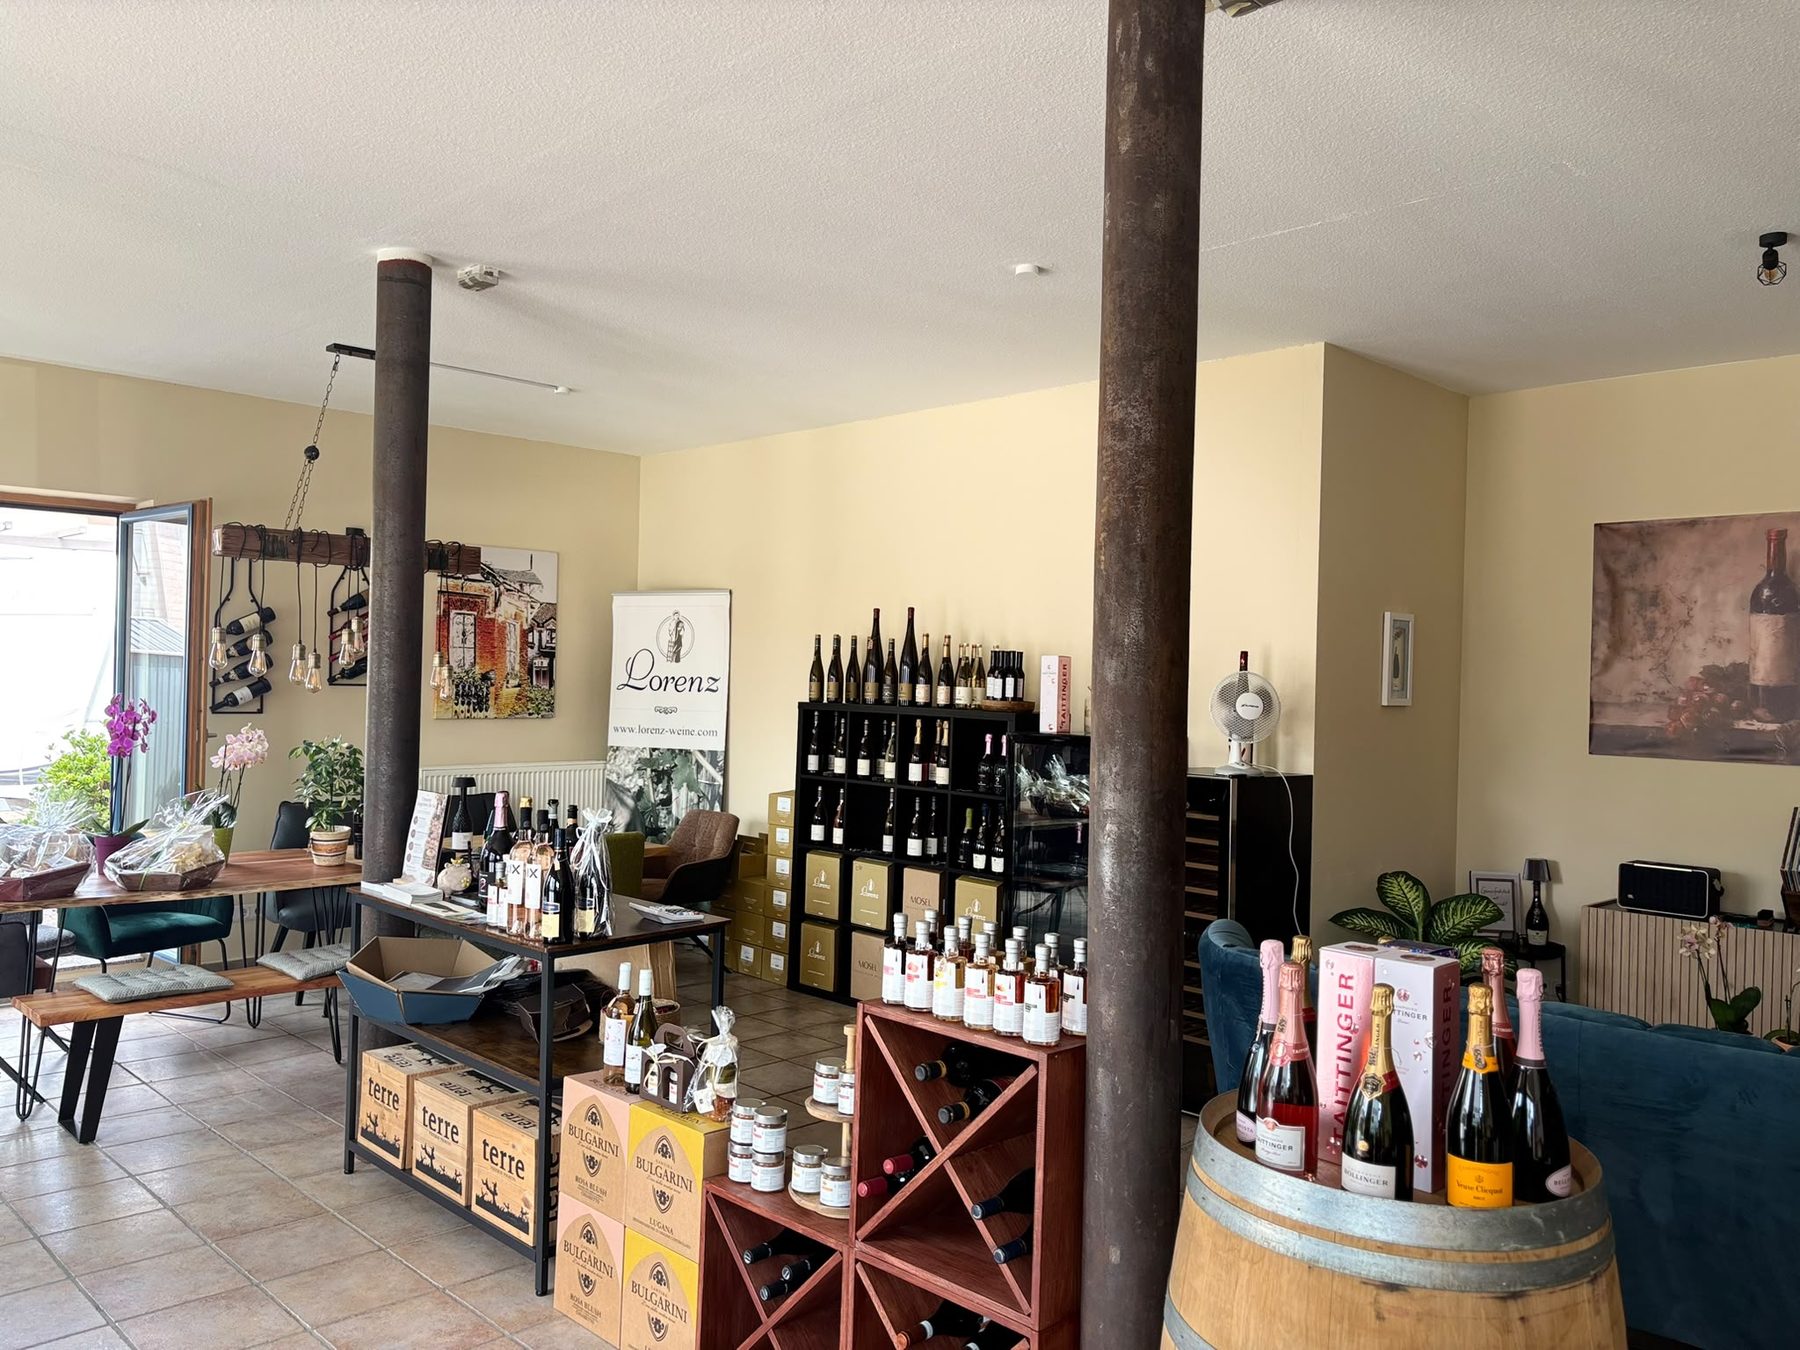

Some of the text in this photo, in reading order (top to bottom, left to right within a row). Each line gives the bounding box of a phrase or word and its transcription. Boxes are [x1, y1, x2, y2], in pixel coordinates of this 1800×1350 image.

[617, 648, 721, 693] Lorenz
[1060, 664, 1068, 727] TAITTINGER
[613, 725, 718, 737] www.lorenz-weine.com
[910, 895, 931, 907] MOSEL
[858, 960, 877, 971] MOSEL
[368, 1076, 400, 1111] terre
[440, 1081, 472, 1097] terre
[422, 1106, 459, 1144] terre
[501, 1111, 537, 1129] terre
[568, 1123, 619, 1157] BULGARINI
[483, 1138, 525, 1180] terre
[636, 1156, 692, 1193] BULGARINI
[1344, 1168, 1389, 1186] BOLLINGER
[1475, 1184, 1503, 1196] Clicquot
[649, 1217, 674, 1236] LUGANA
[563, 1240, 613, 1279] BULGARINI
[631, 1280, 687, 1323] BULGARINI
